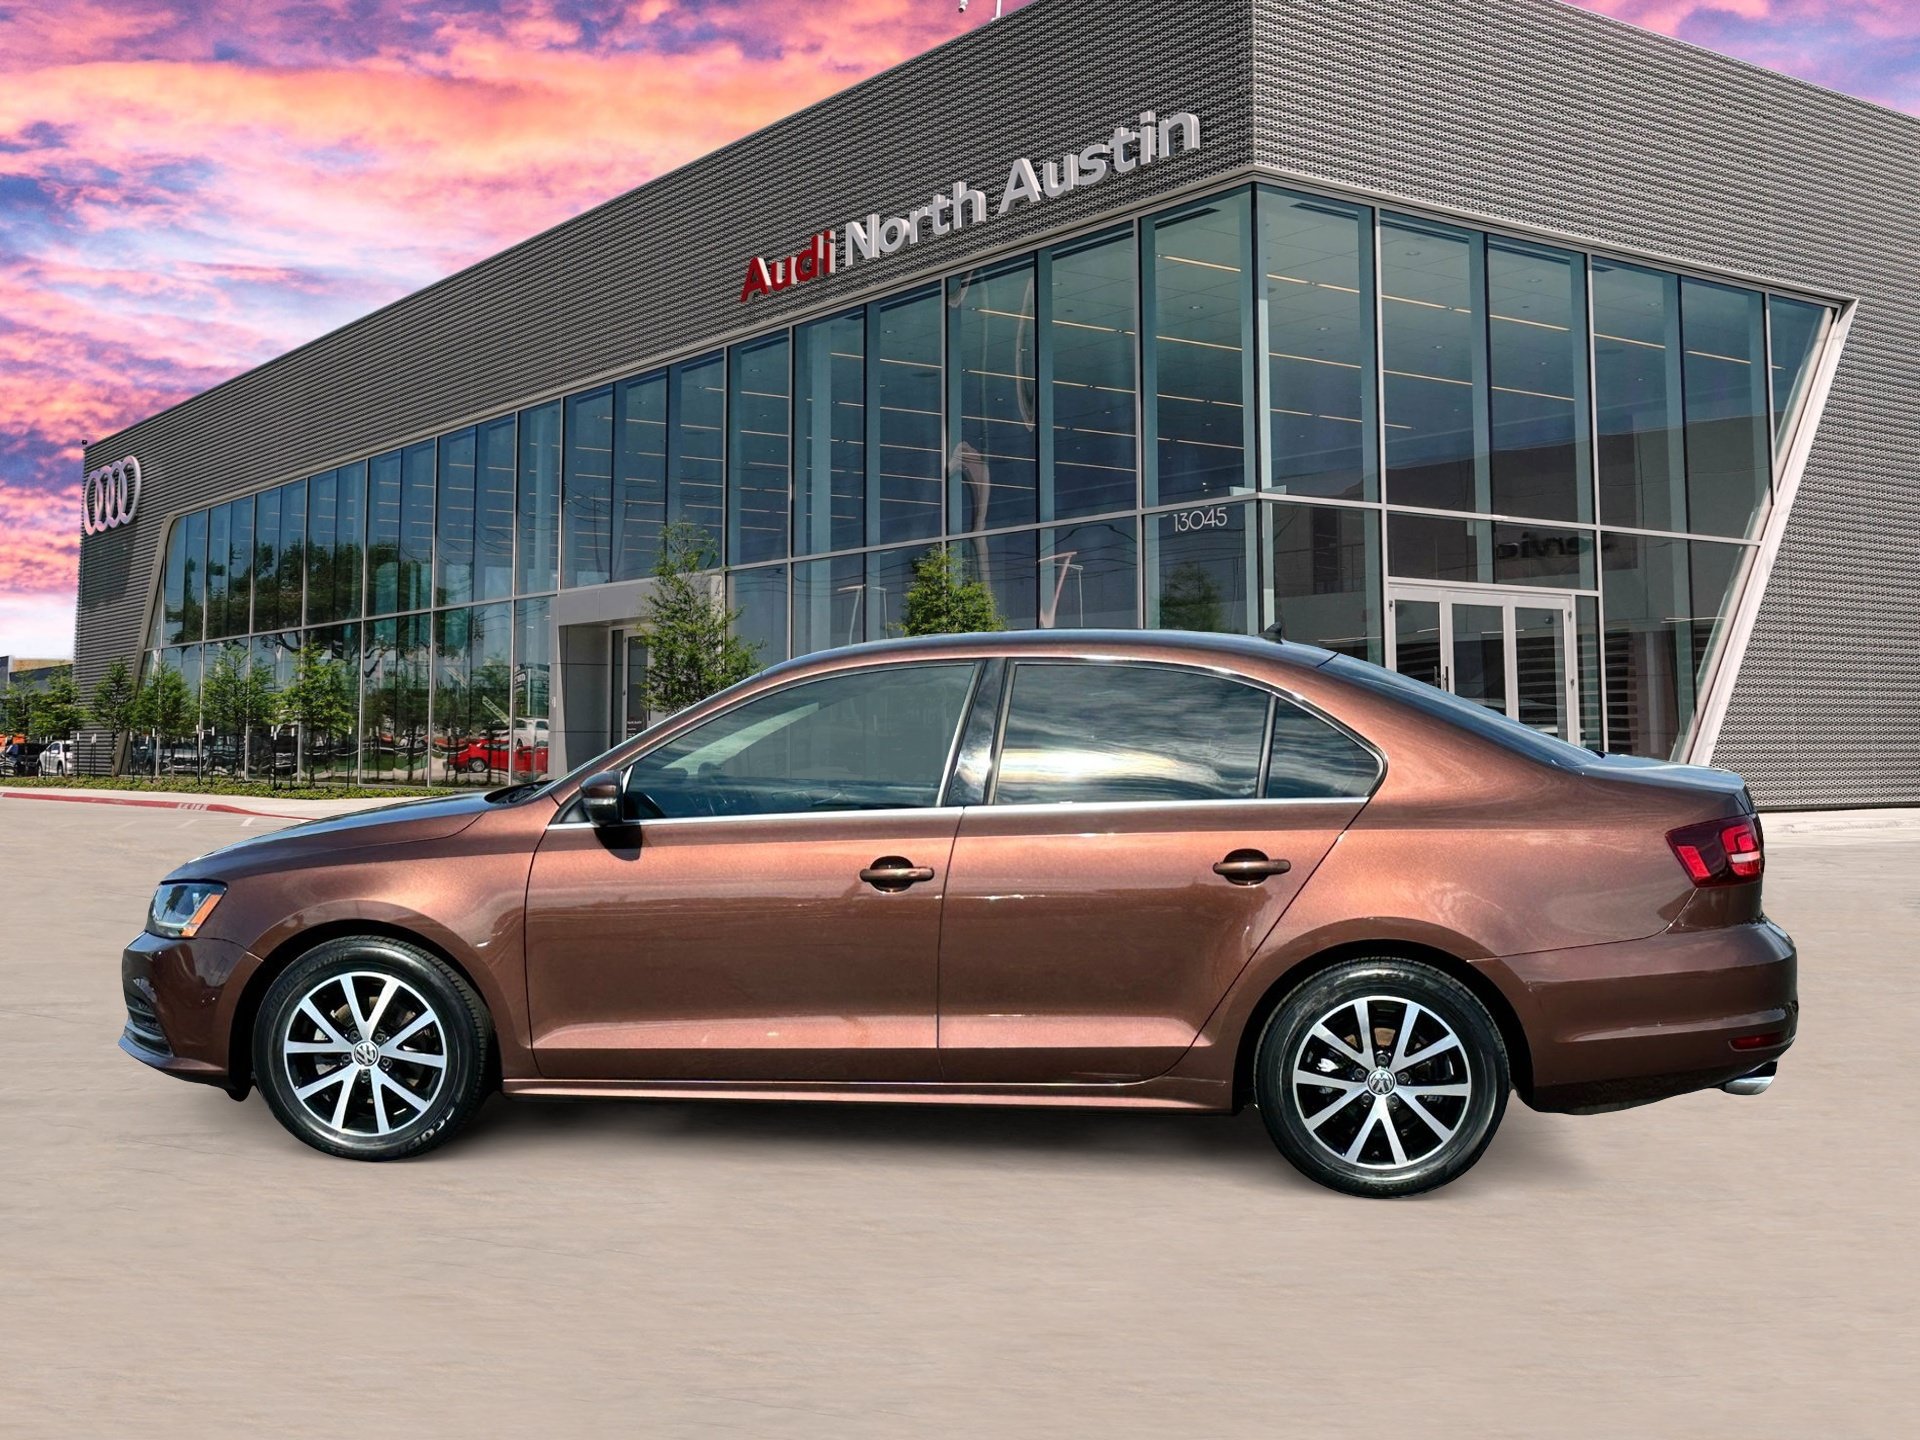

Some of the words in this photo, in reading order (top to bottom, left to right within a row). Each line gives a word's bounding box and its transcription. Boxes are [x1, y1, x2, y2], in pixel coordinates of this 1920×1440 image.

[741, 229, 837, 303] Audi
[845, 181, 987, 267] North
[1000, 110, 1200, 214] Austin
[1173, 506, 1228, 532] 13045
